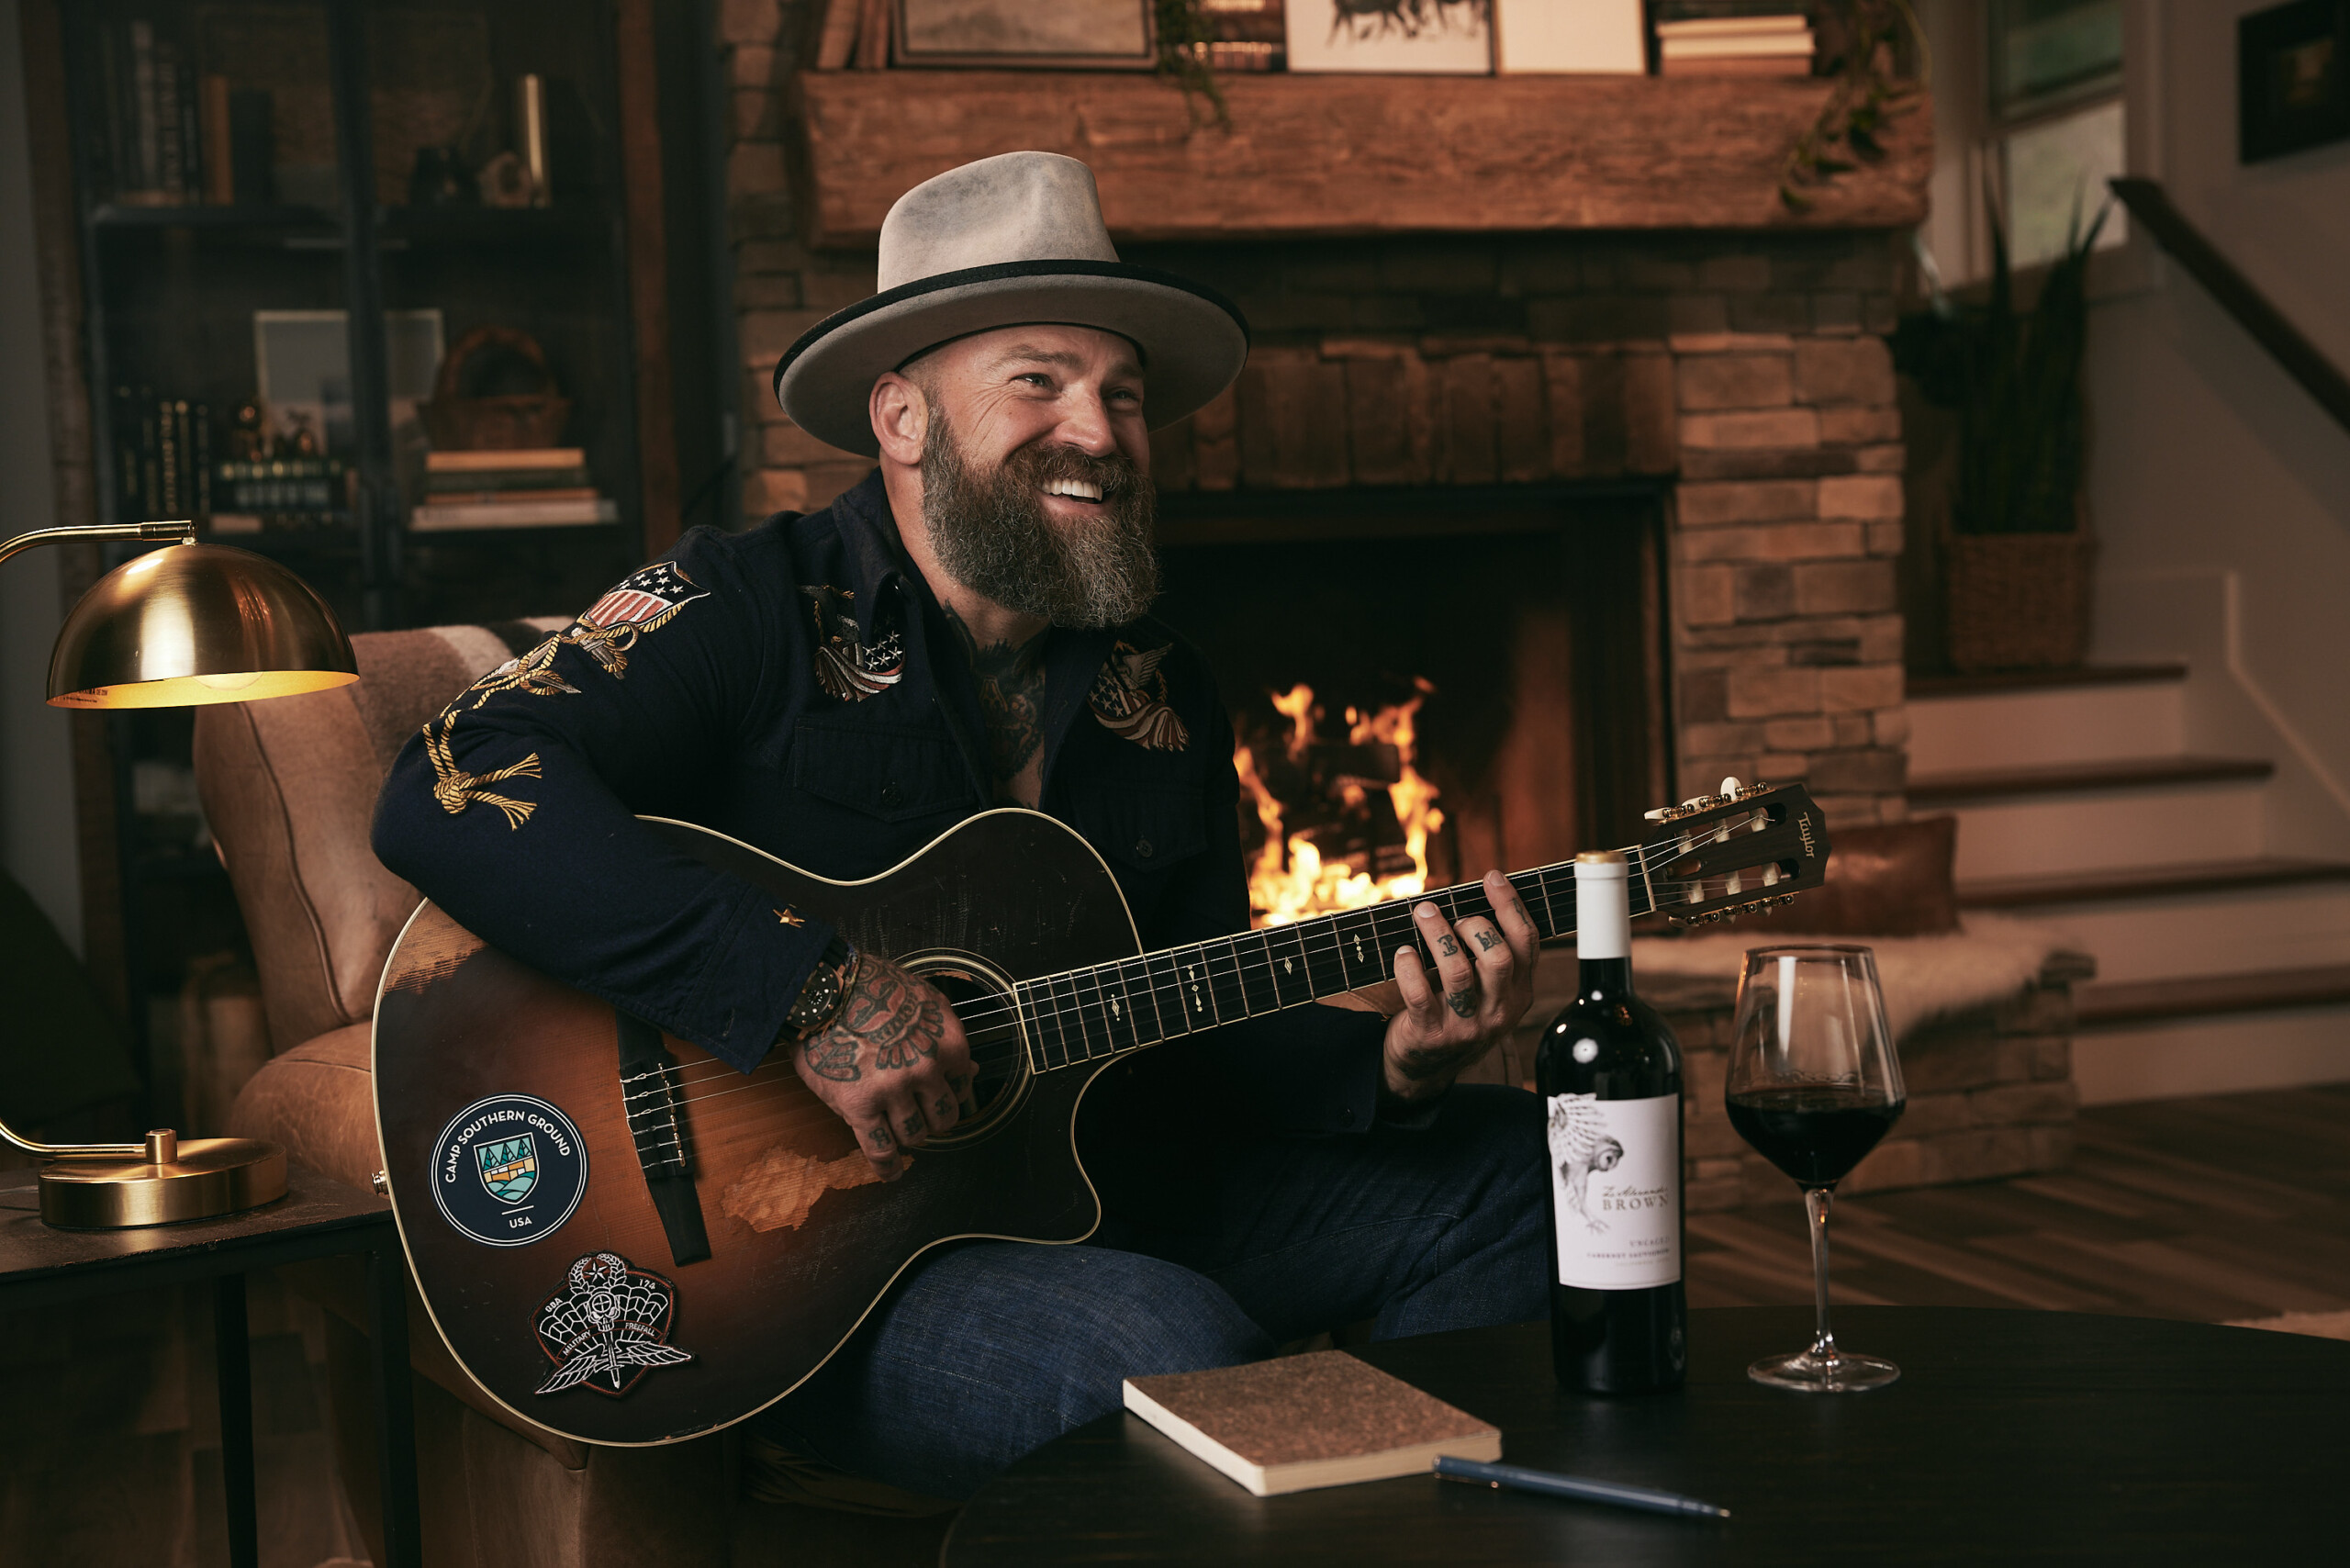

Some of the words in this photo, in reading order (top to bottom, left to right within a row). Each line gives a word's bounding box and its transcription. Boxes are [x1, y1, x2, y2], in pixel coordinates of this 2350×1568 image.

[1797, 812, 1815, 858] Taylor
[445, 1144, 461, 1183] CAMP
[457, 1110, 525, 1145] SOUTHERN
[527, 1114, 571, 1157] GROUND
[1602, 1194, 1669, 1211] BROWN
[509, 1215, 532, 1228] USA
[562, 1330, 592, 1356] MILITARY
[624, 1322, 655, 1337] FREEFALL
